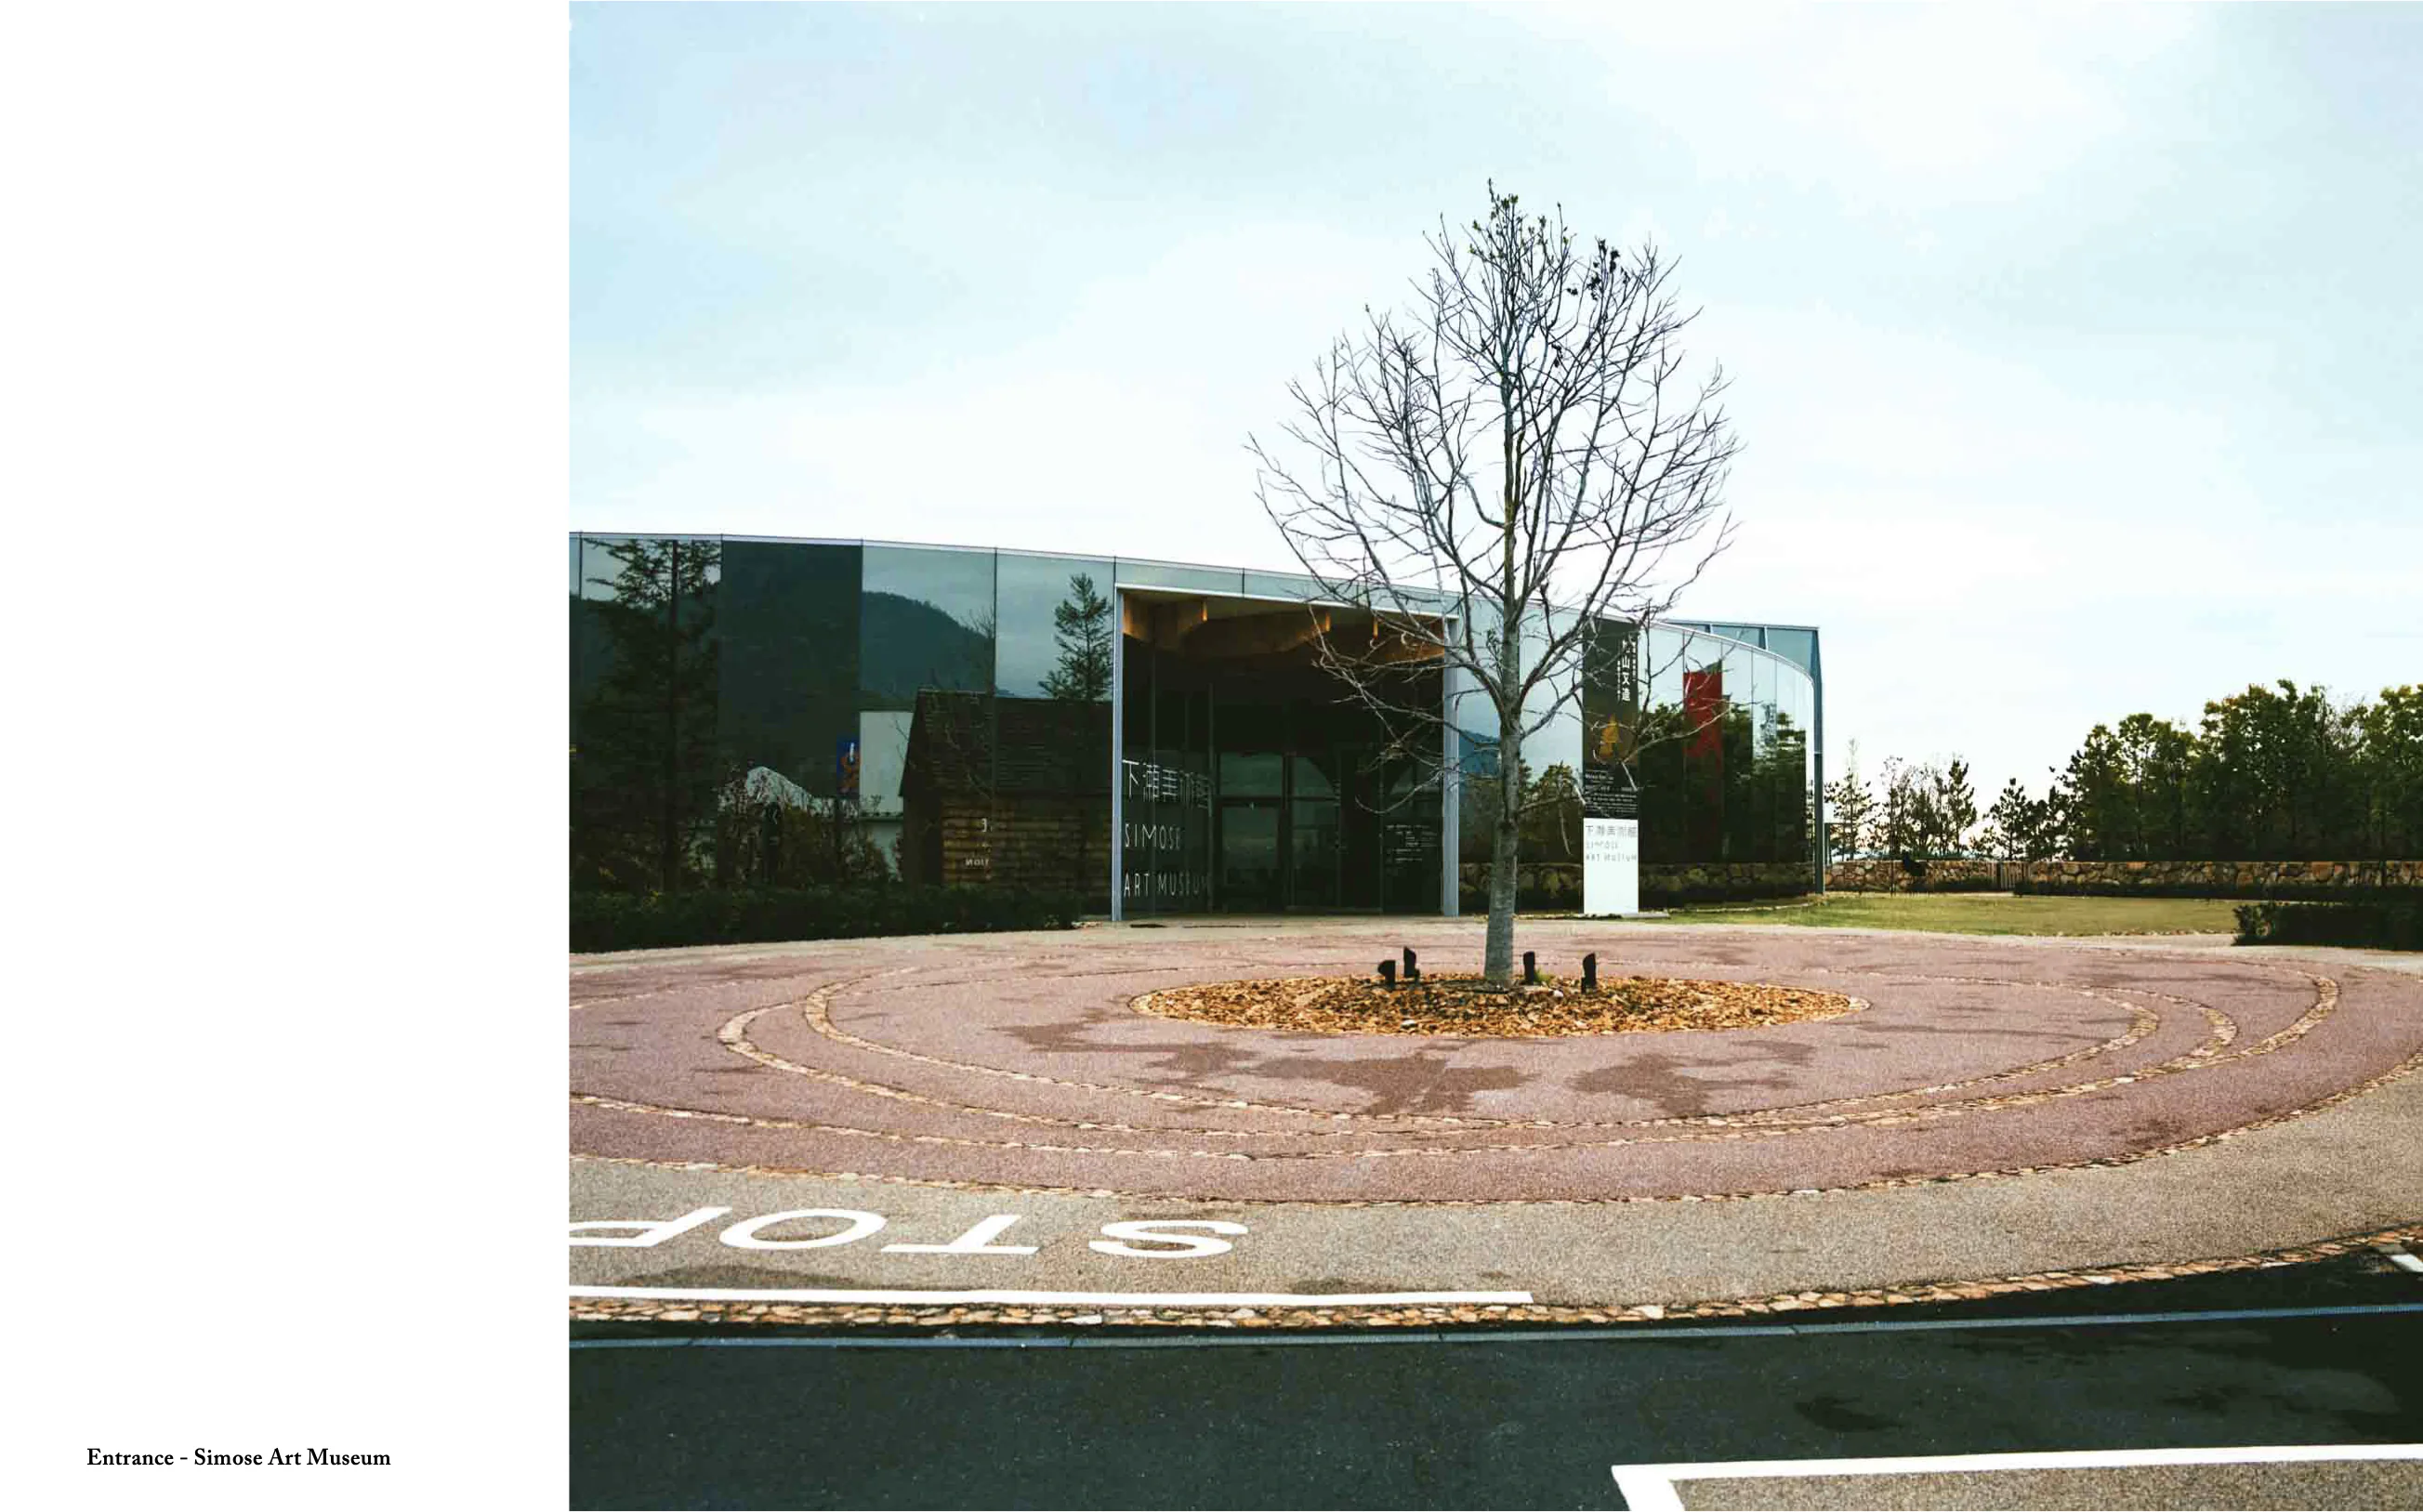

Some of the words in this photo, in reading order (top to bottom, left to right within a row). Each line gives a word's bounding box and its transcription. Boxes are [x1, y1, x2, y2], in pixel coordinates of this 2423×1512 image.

[1124, 822, 1182, 851] SIMOSE
[1123, 872, 1150, 899] ART
[570, 1206, 1250, 1258] STOP
